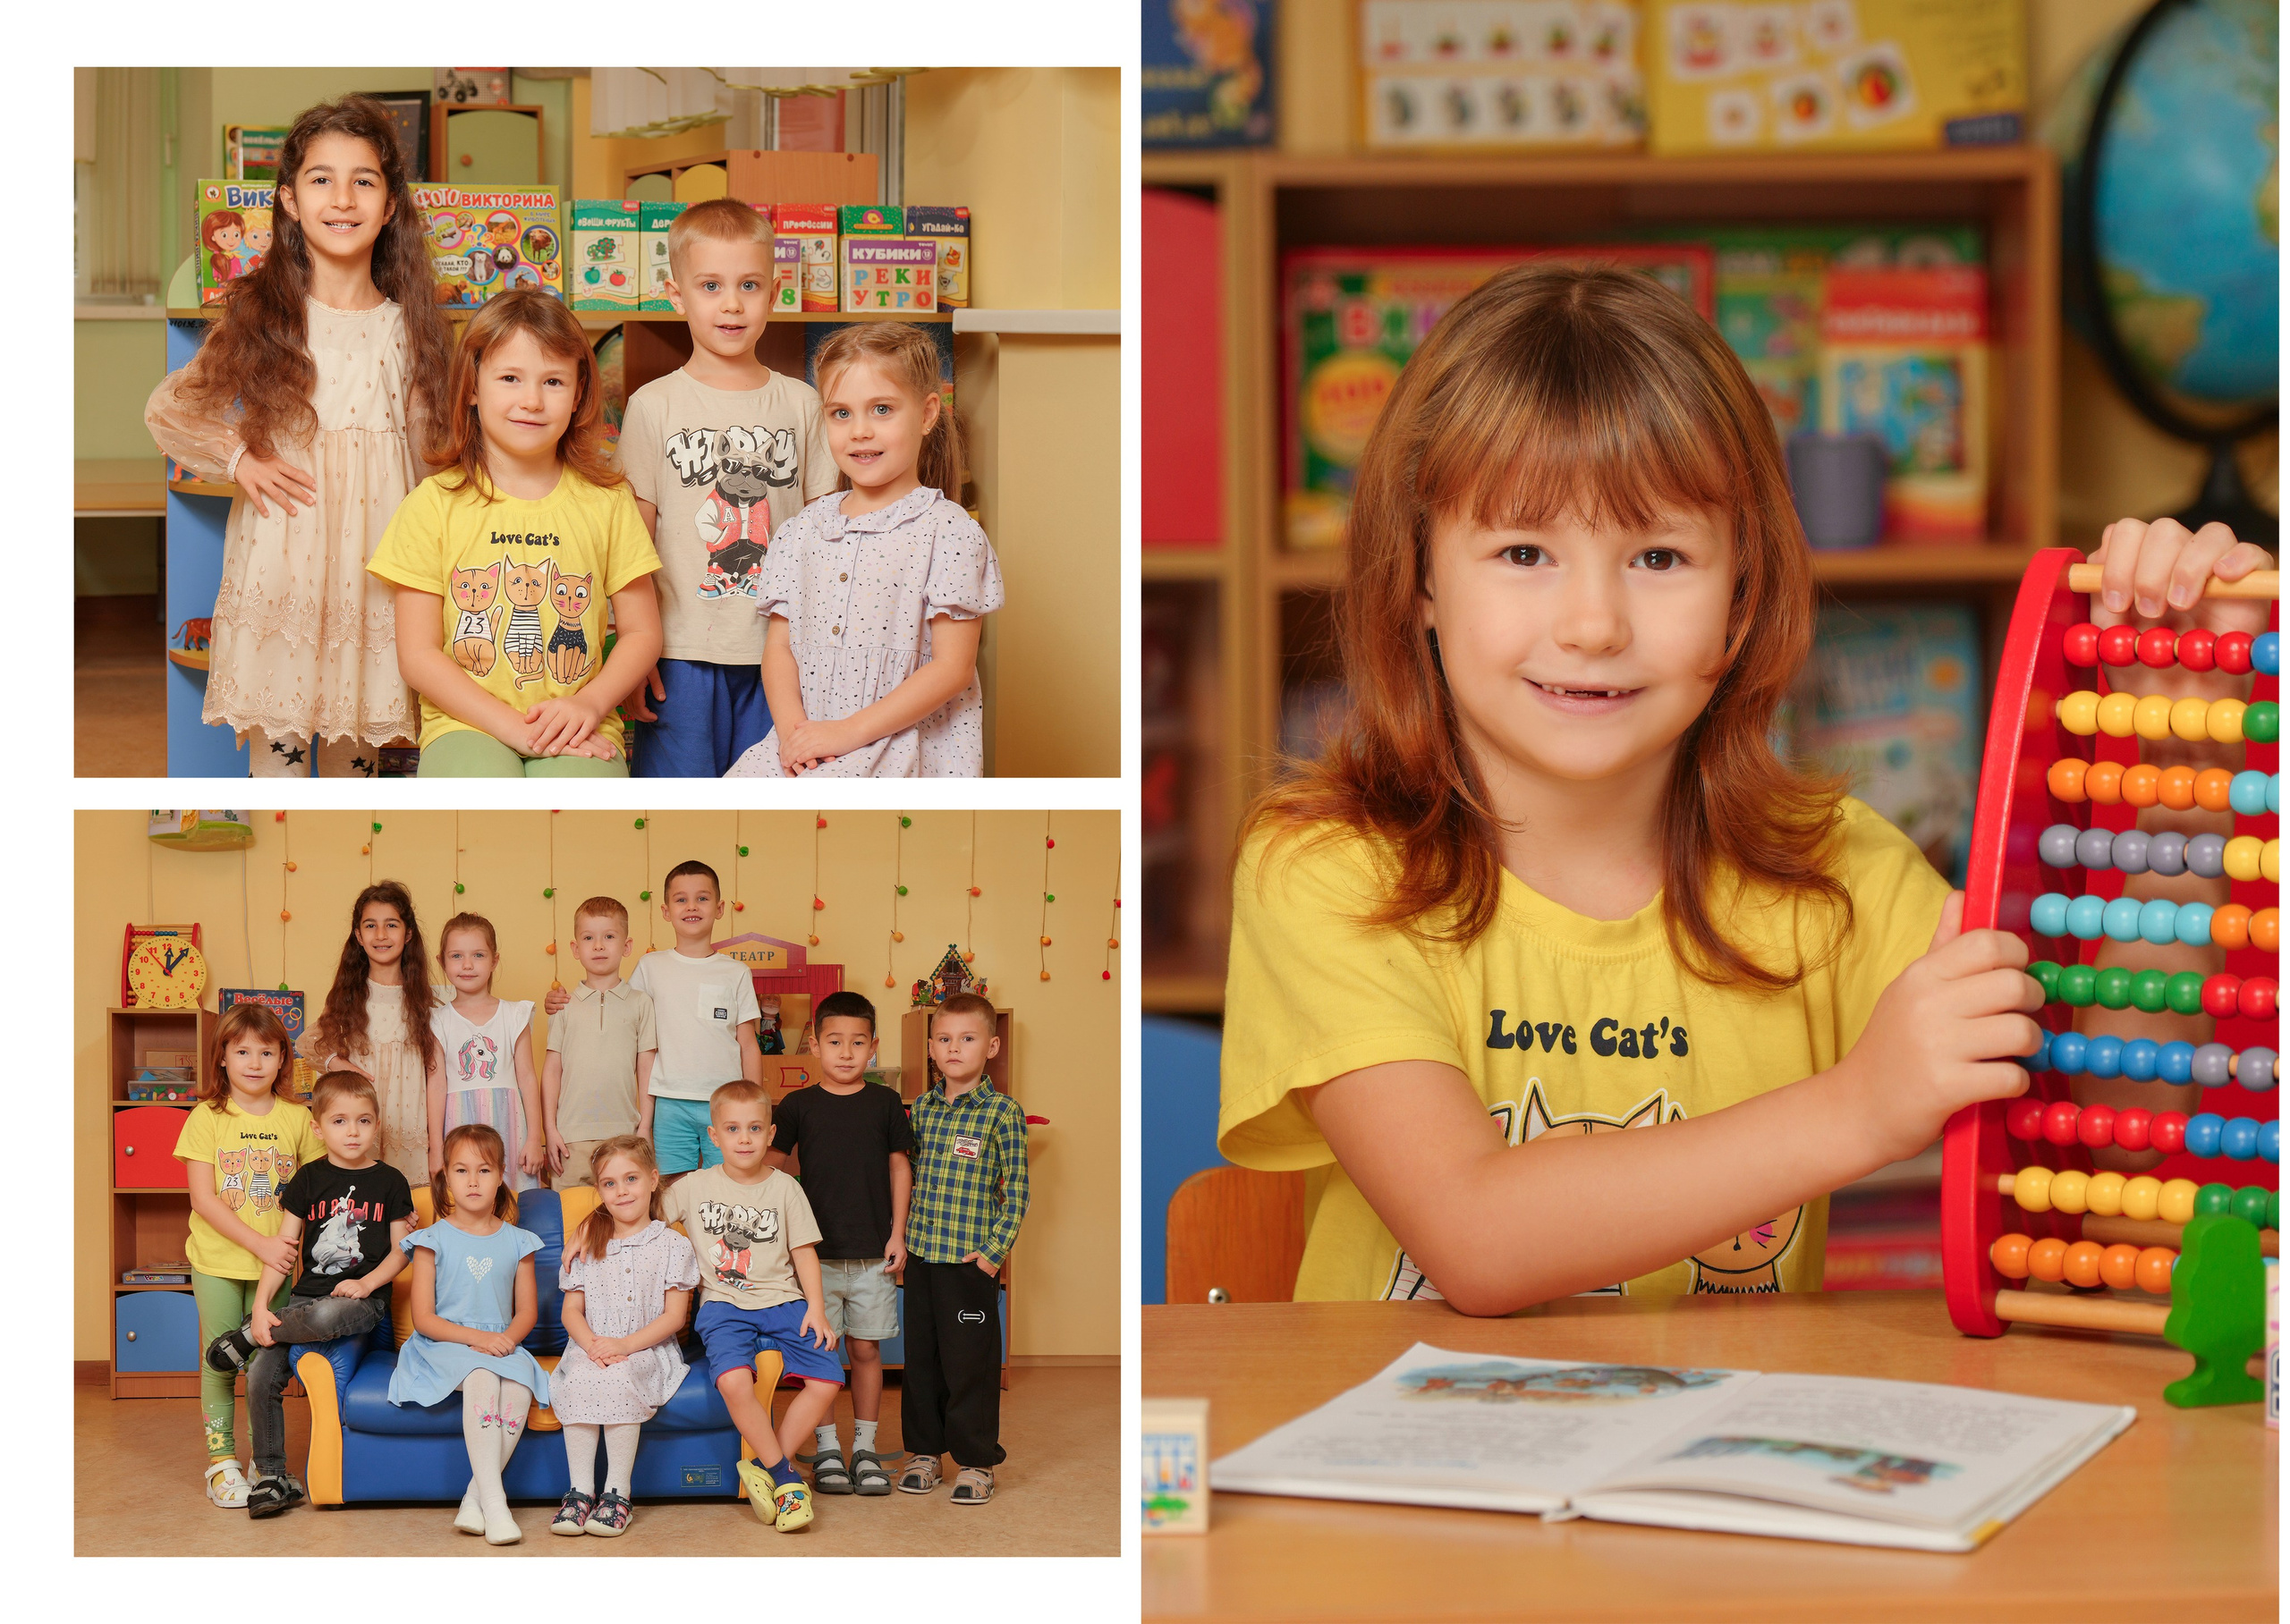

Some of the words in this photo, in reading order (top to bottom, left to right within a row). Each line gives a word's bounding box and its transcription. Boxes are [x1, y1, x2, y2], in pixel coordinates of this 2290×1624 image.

[852, 248, 921, 260] КУБИКИ
[723, 507, 736, 522] A
[490, 531, 522, 545] Love
[525, 533, 560, 546] Cat's
[463, 615, 485, 635] 23
[730, 951, 776, 961] ТЕАТР
[233, 993, 293, 1005] Весёлые
[1486, 1009, 1578, 1055] Love
[1590, 1016, 1689, 1060] Cat's
[240, 1131, 258, 1139] Love
[259, 1132, 278, 1140] Cat's
[226, 1176, 239, 1188] 23
